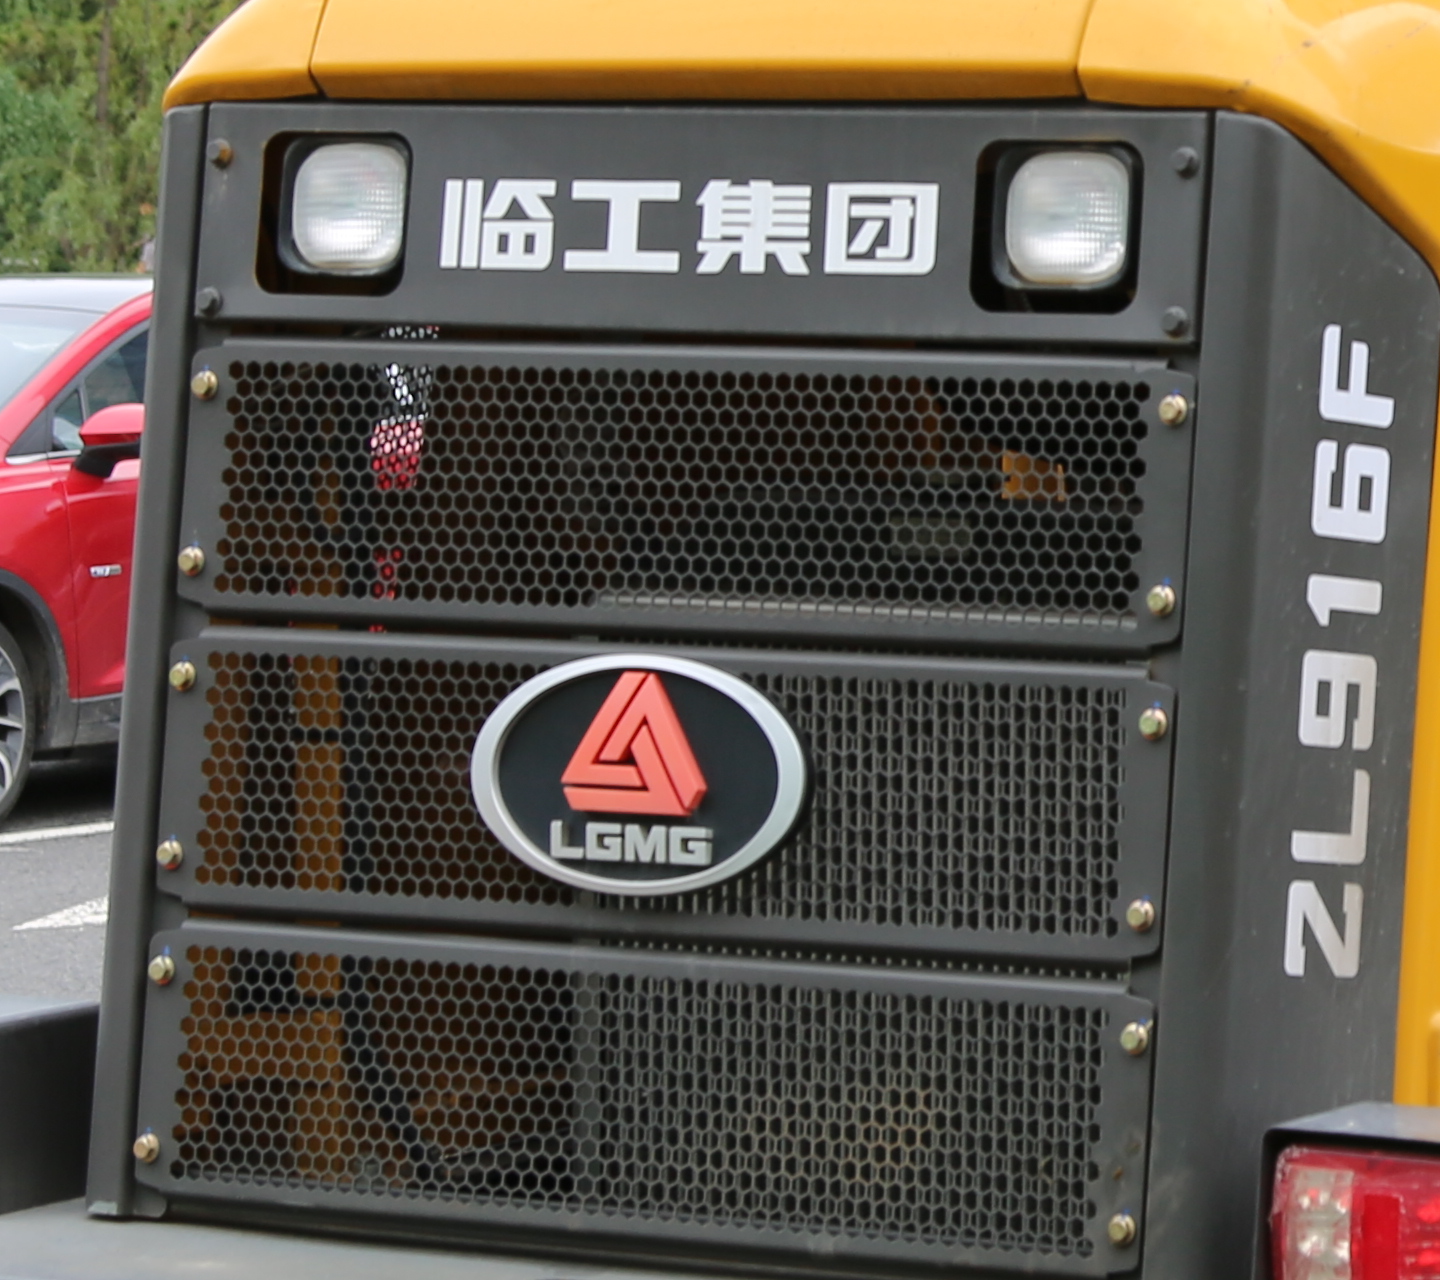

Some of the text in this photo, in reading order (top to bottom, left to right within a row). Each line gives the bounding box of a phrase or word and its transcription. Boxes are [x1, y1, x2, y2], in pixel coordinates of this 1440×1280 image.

[439, 178, 940, 276] 临工集团
[1283, 323, 1396, 979] ZL916F
[550, 820, 714, 867] LGMG
